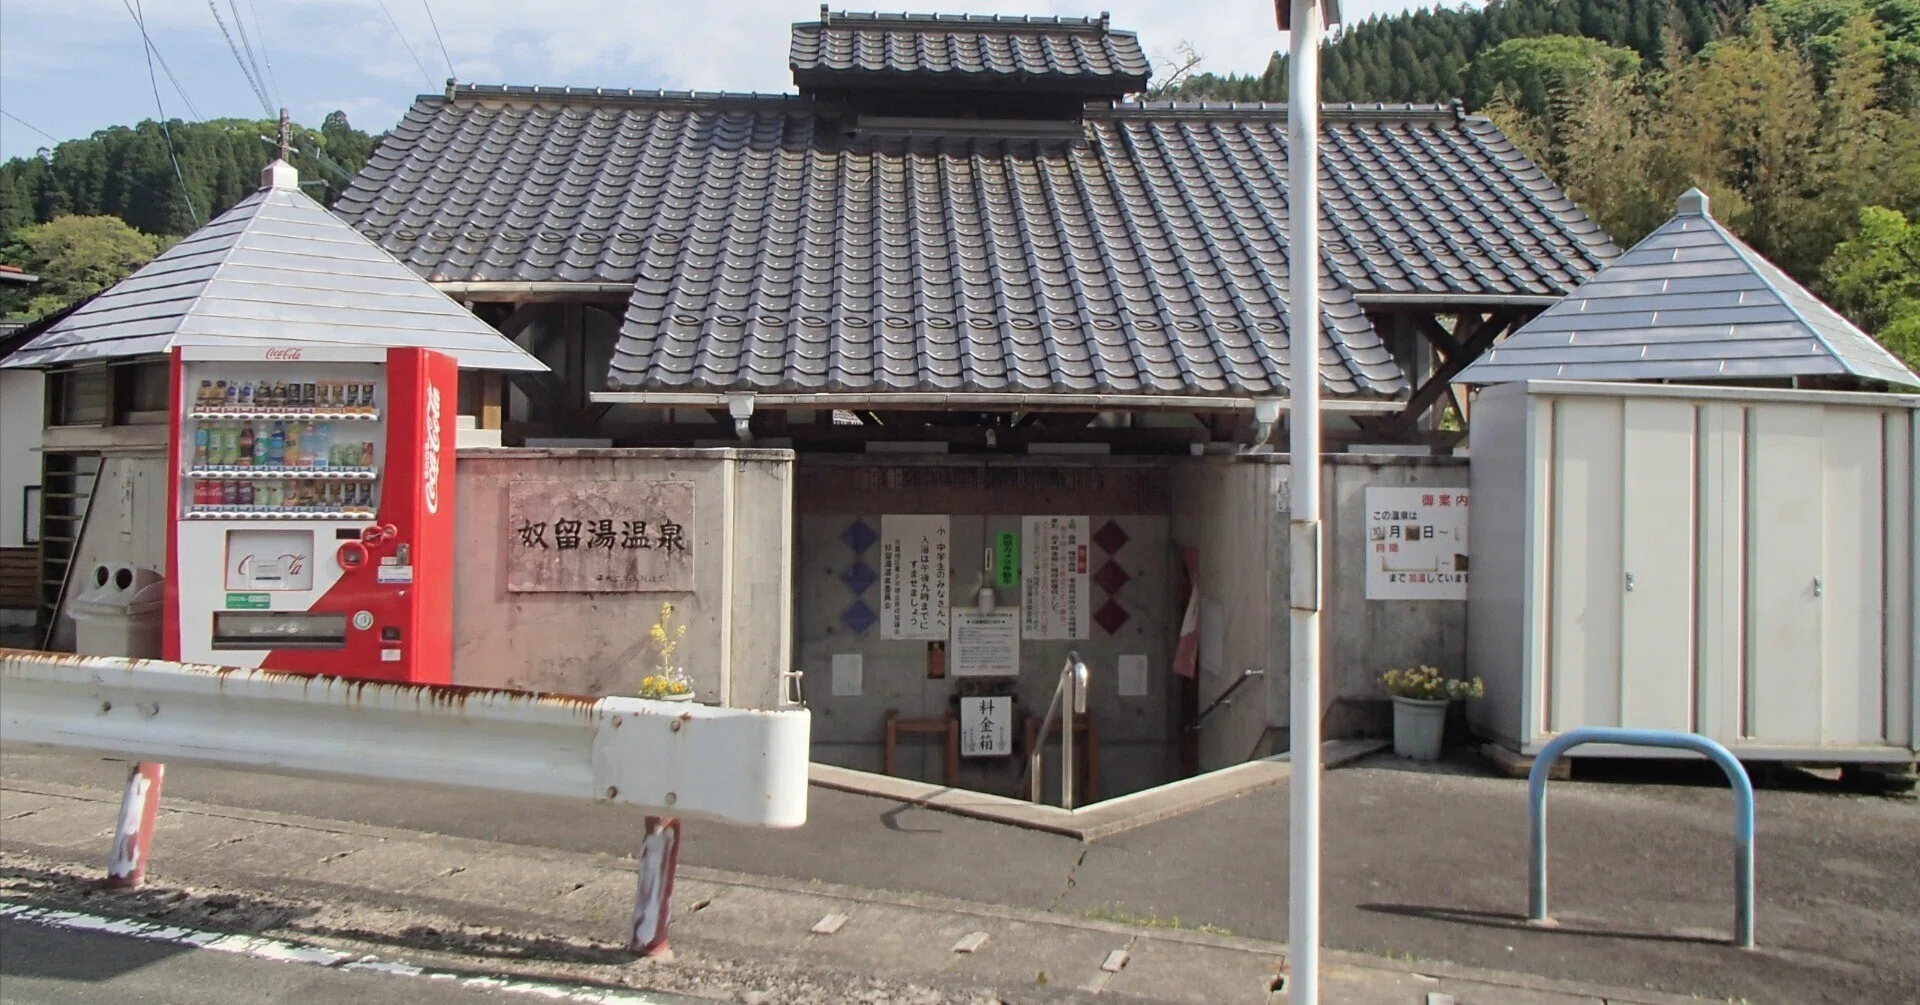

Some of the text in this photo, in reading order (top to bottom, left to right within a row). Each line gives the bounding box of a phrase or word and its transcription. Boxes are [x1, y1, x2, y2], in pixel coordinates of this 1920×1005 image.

[518, 517, 686, 551] 奴留湯温泉
[1373, 511, 1417, 521] この温泉は
[910, 560, 919, 626] すませましょう
[920, 535, 930, 630] 入浴は午後九時までに
[979, 698, 995, 751] 料金箱
